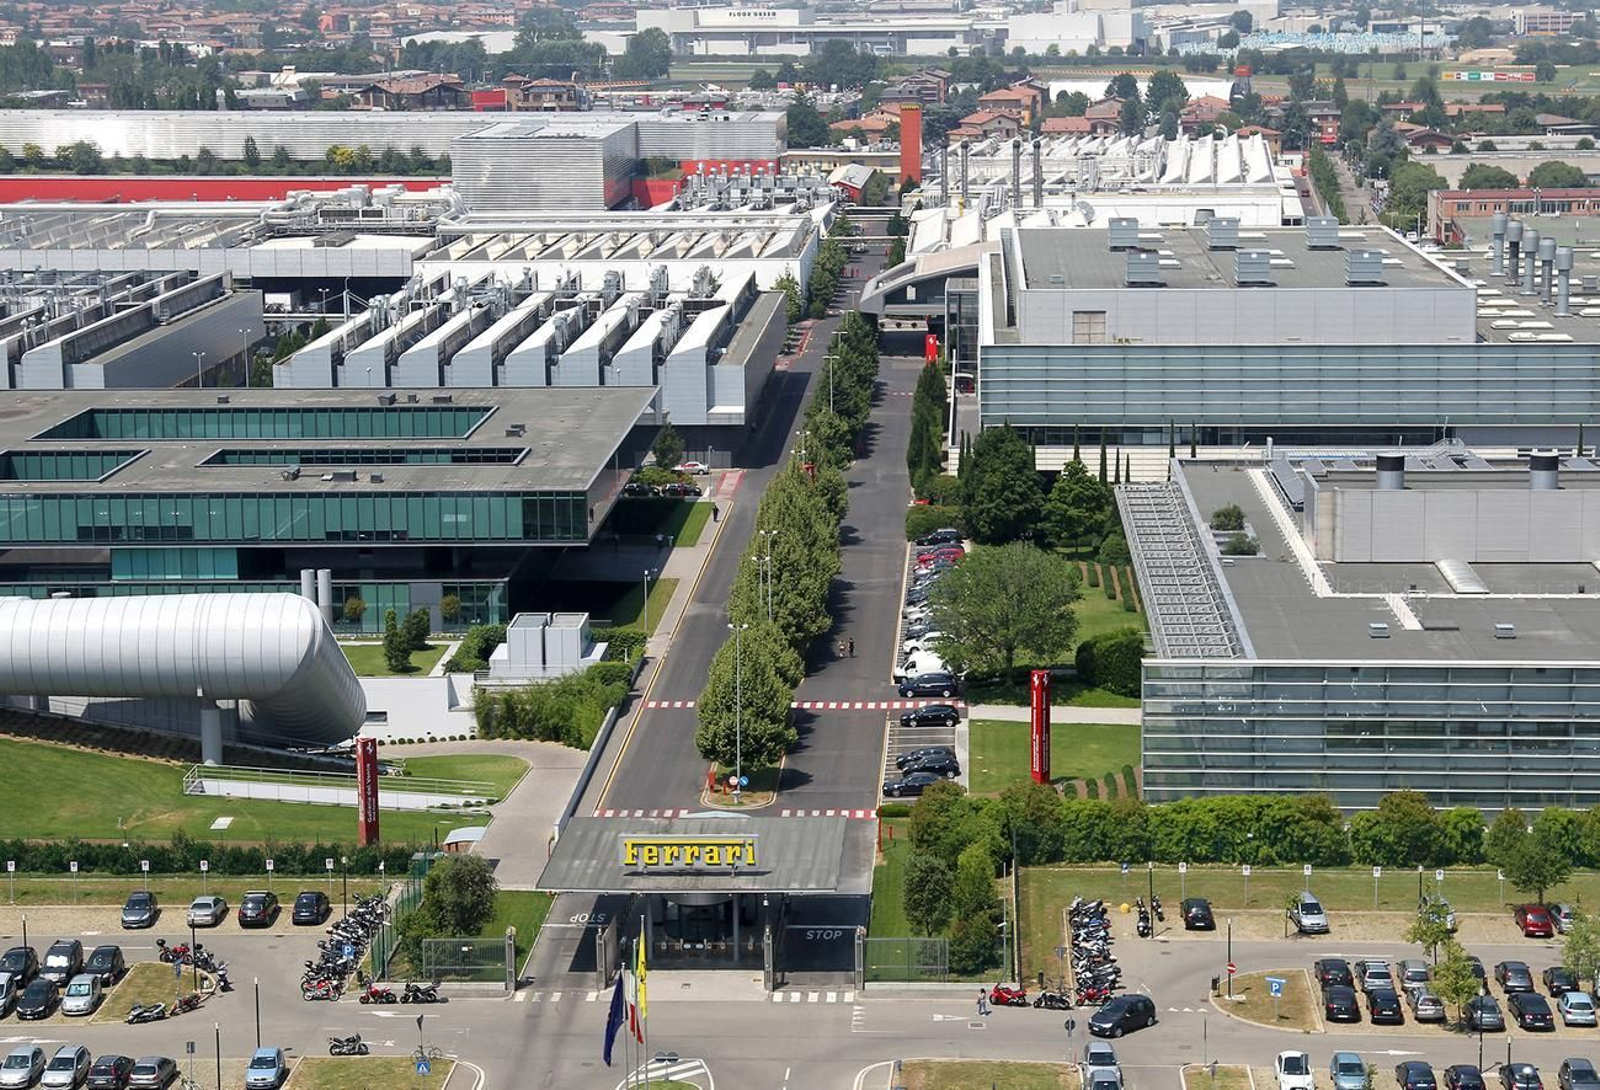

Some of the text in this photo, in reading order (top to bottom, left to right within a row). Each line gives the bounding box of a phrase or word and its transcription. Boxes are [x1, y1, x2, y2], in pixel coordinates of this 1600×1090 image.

[624, 839, 757, 866] Ferrari
[569, 913, 607, 923] STOP
[806, 929, 843, 939] STOP
